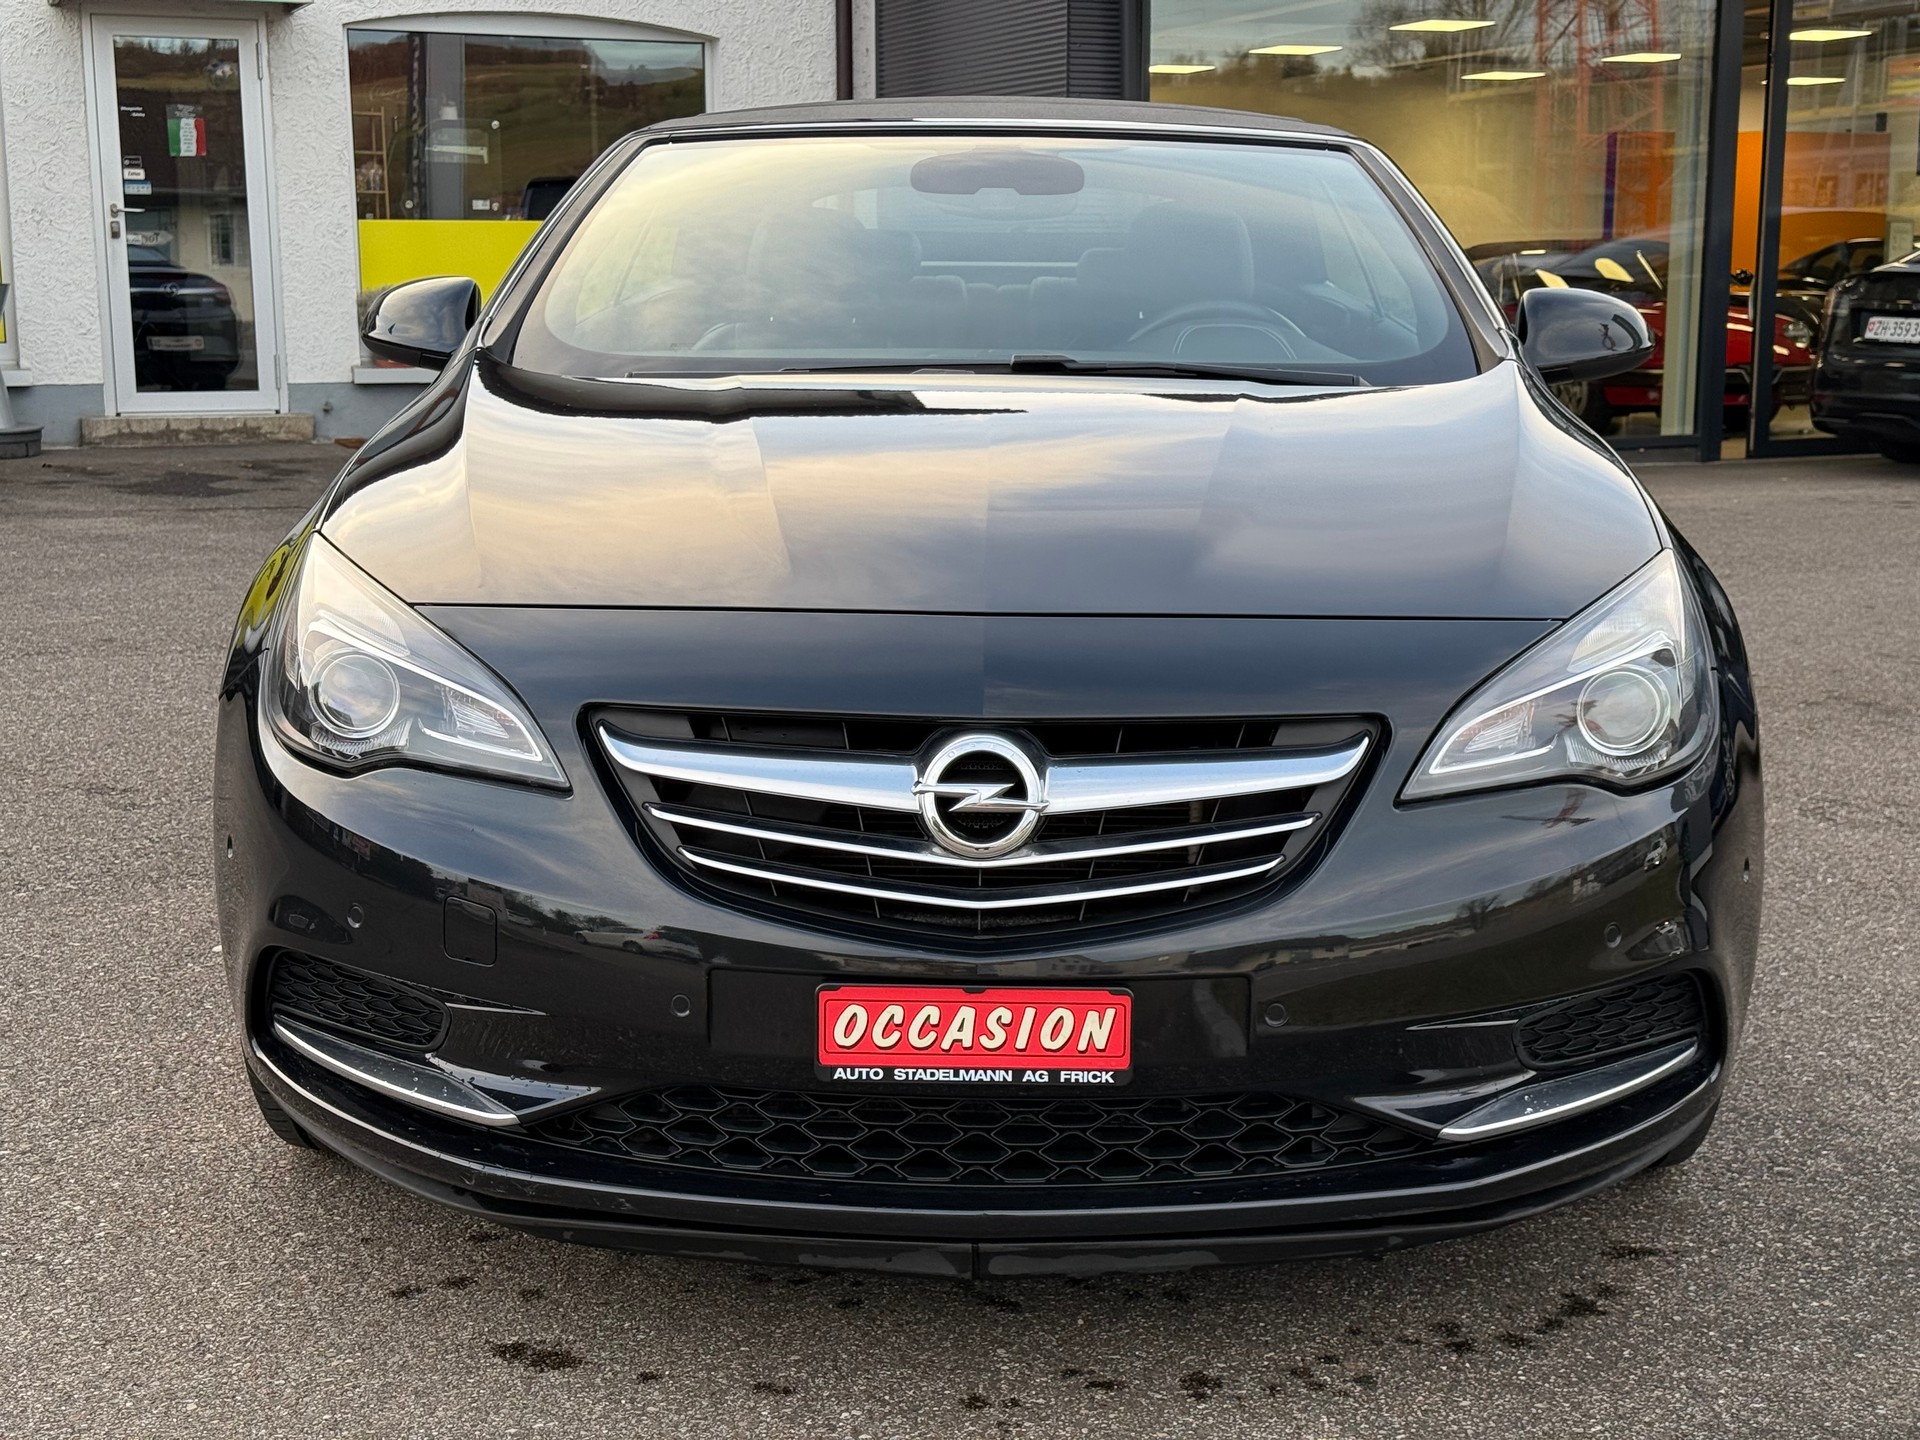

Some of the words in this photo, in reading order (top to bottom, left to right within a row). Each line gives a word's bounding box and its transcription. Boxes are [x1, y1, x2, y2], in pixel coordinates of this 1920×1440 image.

[833, 1004, 1117, 1053] OCCASION
[833, 1067, 884, 1081] AUTO
[894, 1068, 1013, 1082] STADELMANN
[1022, 1070, 1049, 1083] AG
[1060, 1071, 1115, 1084] FRICK
